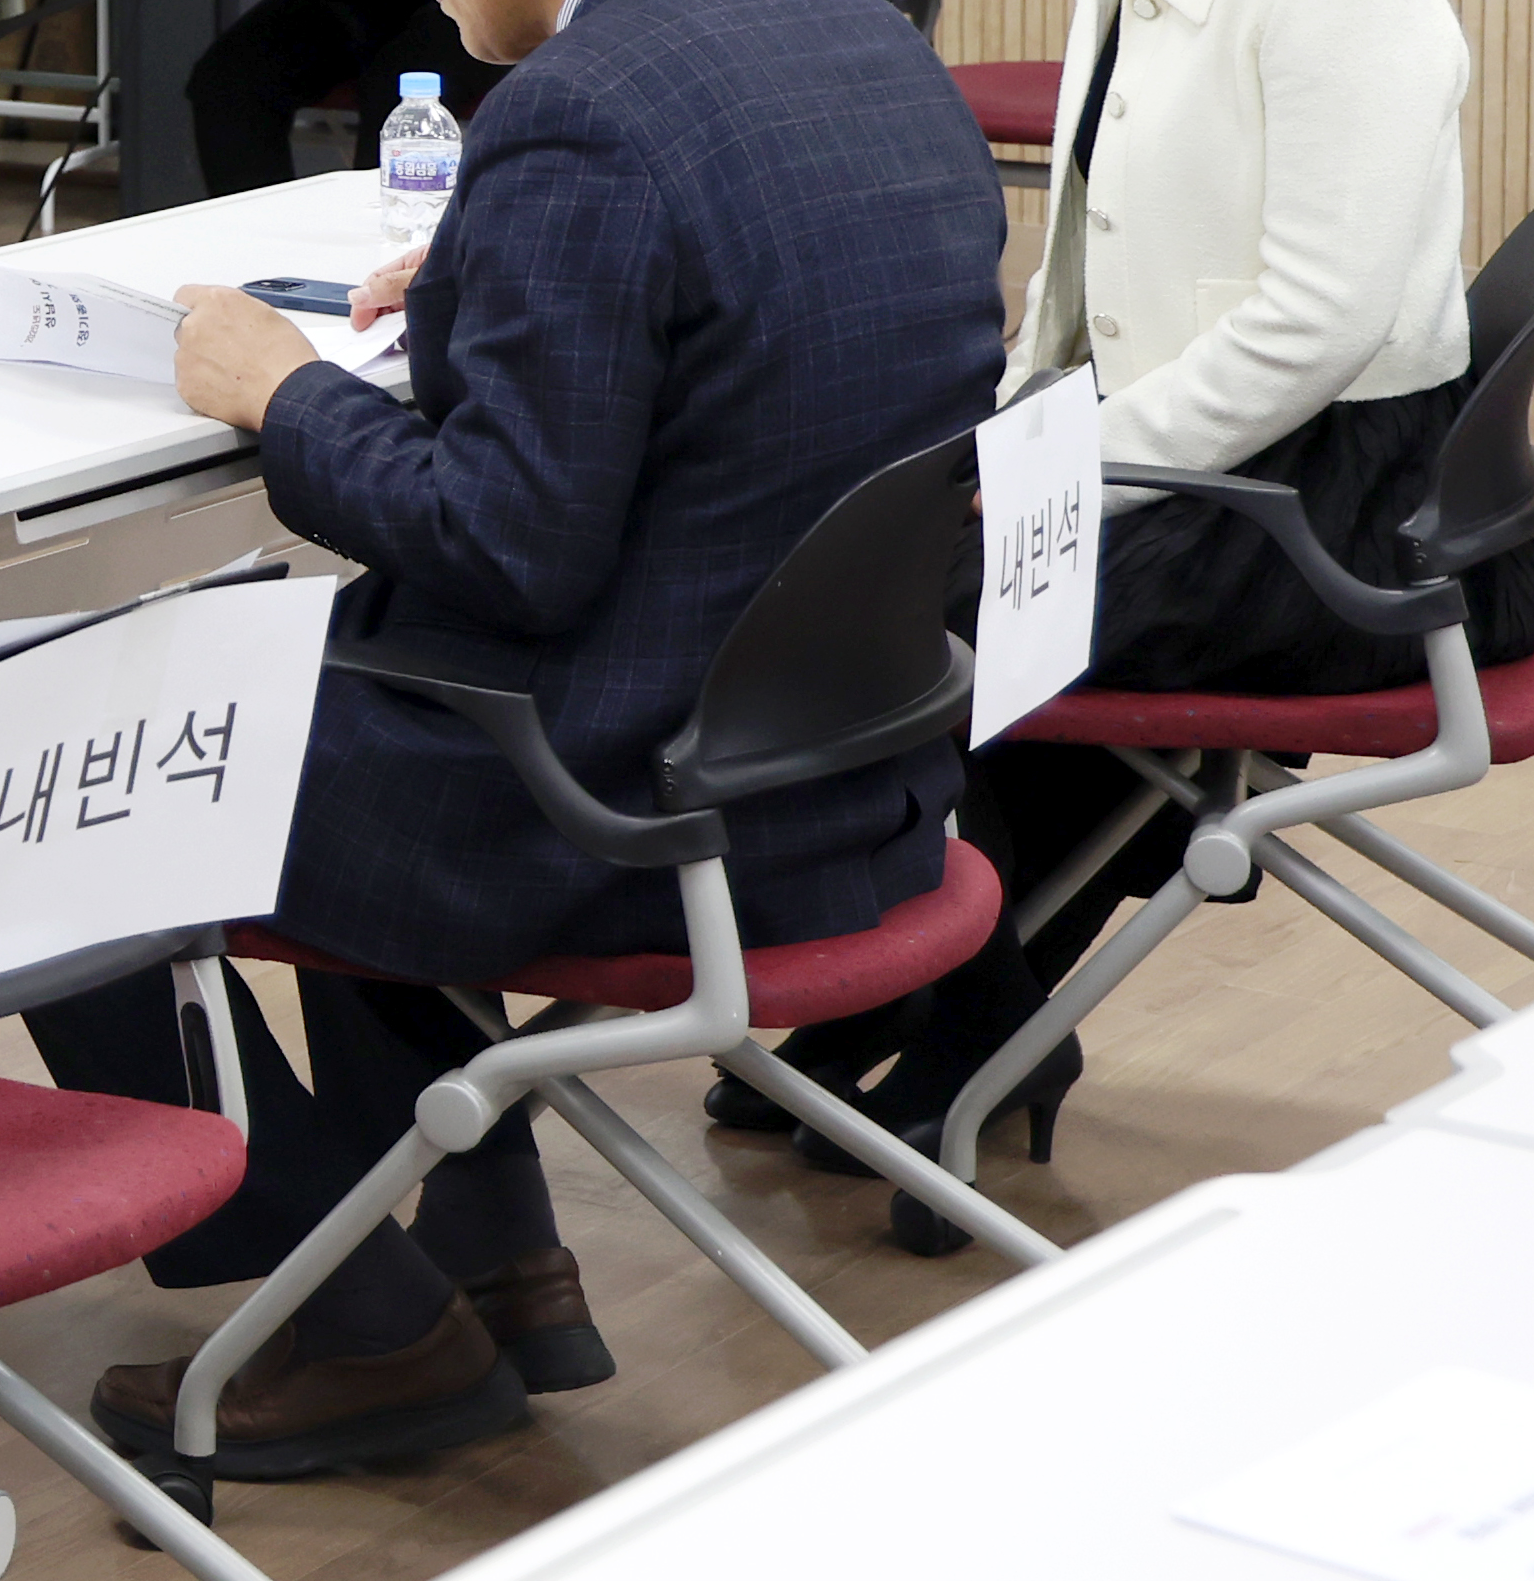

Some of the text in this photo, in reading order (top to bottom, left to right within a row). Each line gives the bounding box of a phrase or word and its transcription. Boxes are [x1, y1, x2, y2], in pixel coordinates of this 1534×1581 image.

[396, 161, 438, 176] 동원샘물
[40, 291, 56, 328] 성남시
[999, 480, 1080, 611] 내빈석
